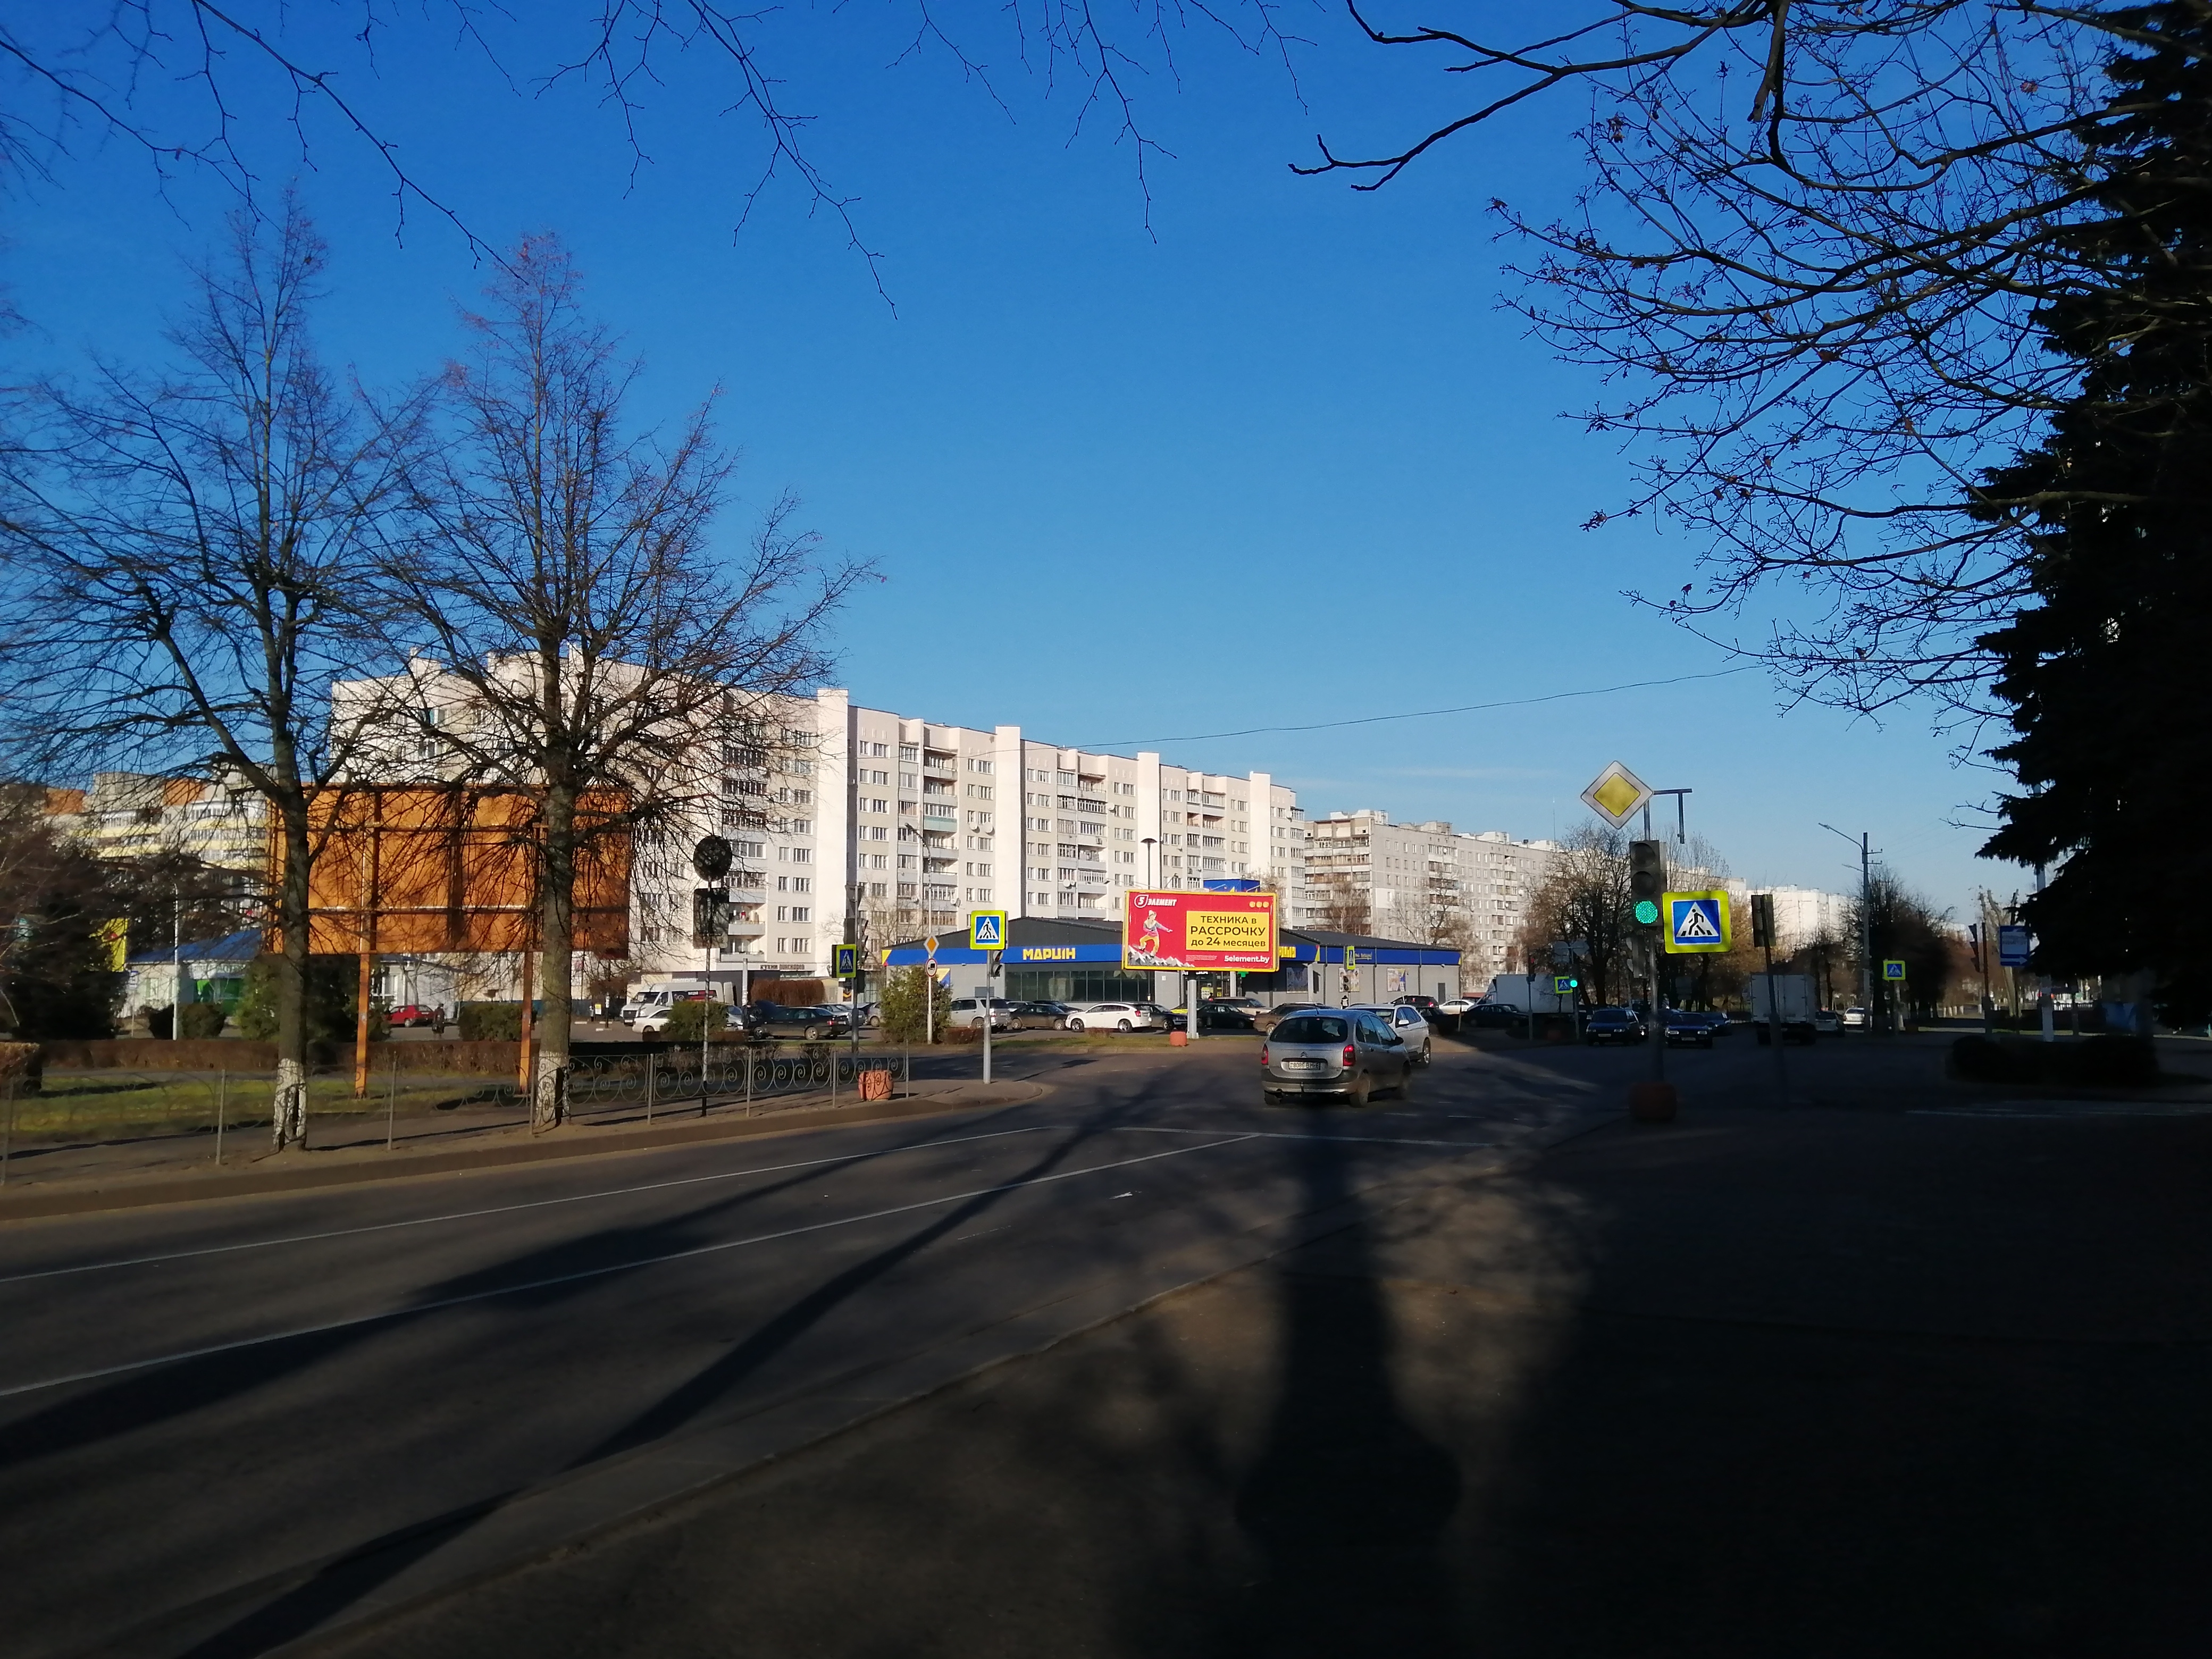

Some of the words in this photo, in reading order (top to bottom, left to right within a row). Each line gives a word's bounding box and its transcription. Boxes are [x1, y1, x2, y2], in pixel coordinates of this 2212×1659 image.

[1147, 898, 1177, 907] ЭЛЕМЕНТ
[1191, 926, 1266, 936] РАССРОЧКУ
[1206, 937, 1221, 945] 24
[1023, 948, 1076, 960] МАРЦІН
[1224, 955, 1270, 963] 5element.by
